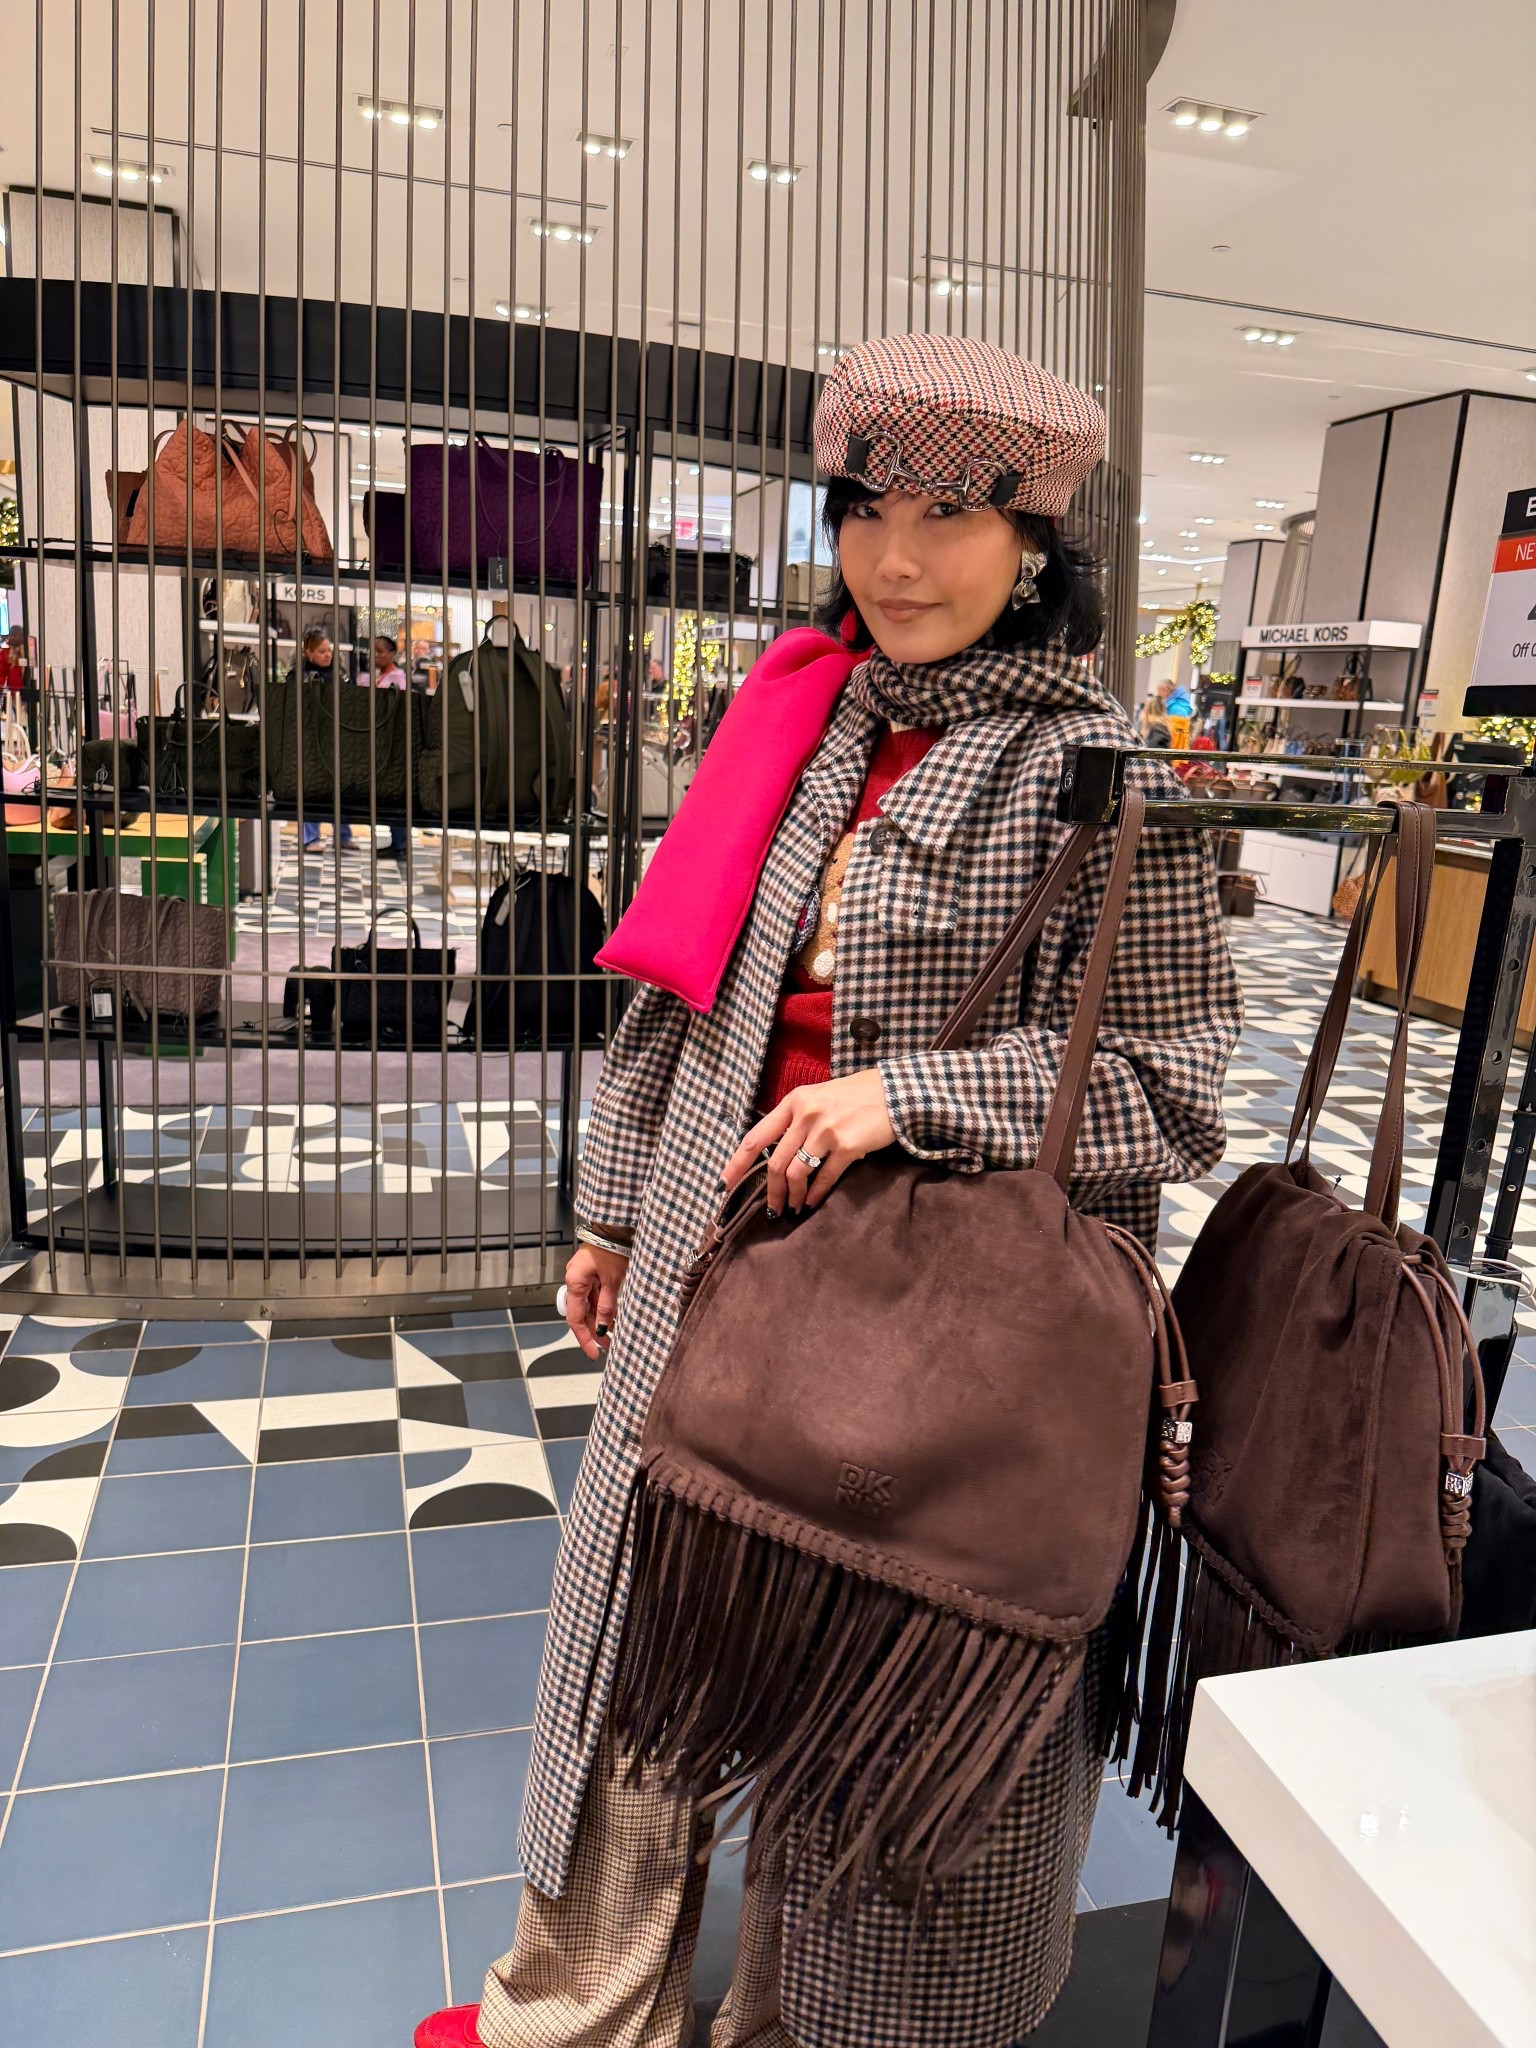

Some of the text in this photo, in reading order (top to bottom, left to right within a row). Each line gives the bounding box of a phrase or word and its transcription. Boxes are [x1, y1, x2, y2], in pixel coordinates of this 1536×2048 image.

[1259, 626, 1349, 643] MICHAEL KORS
[1512, 642, 1530, 658] Off
